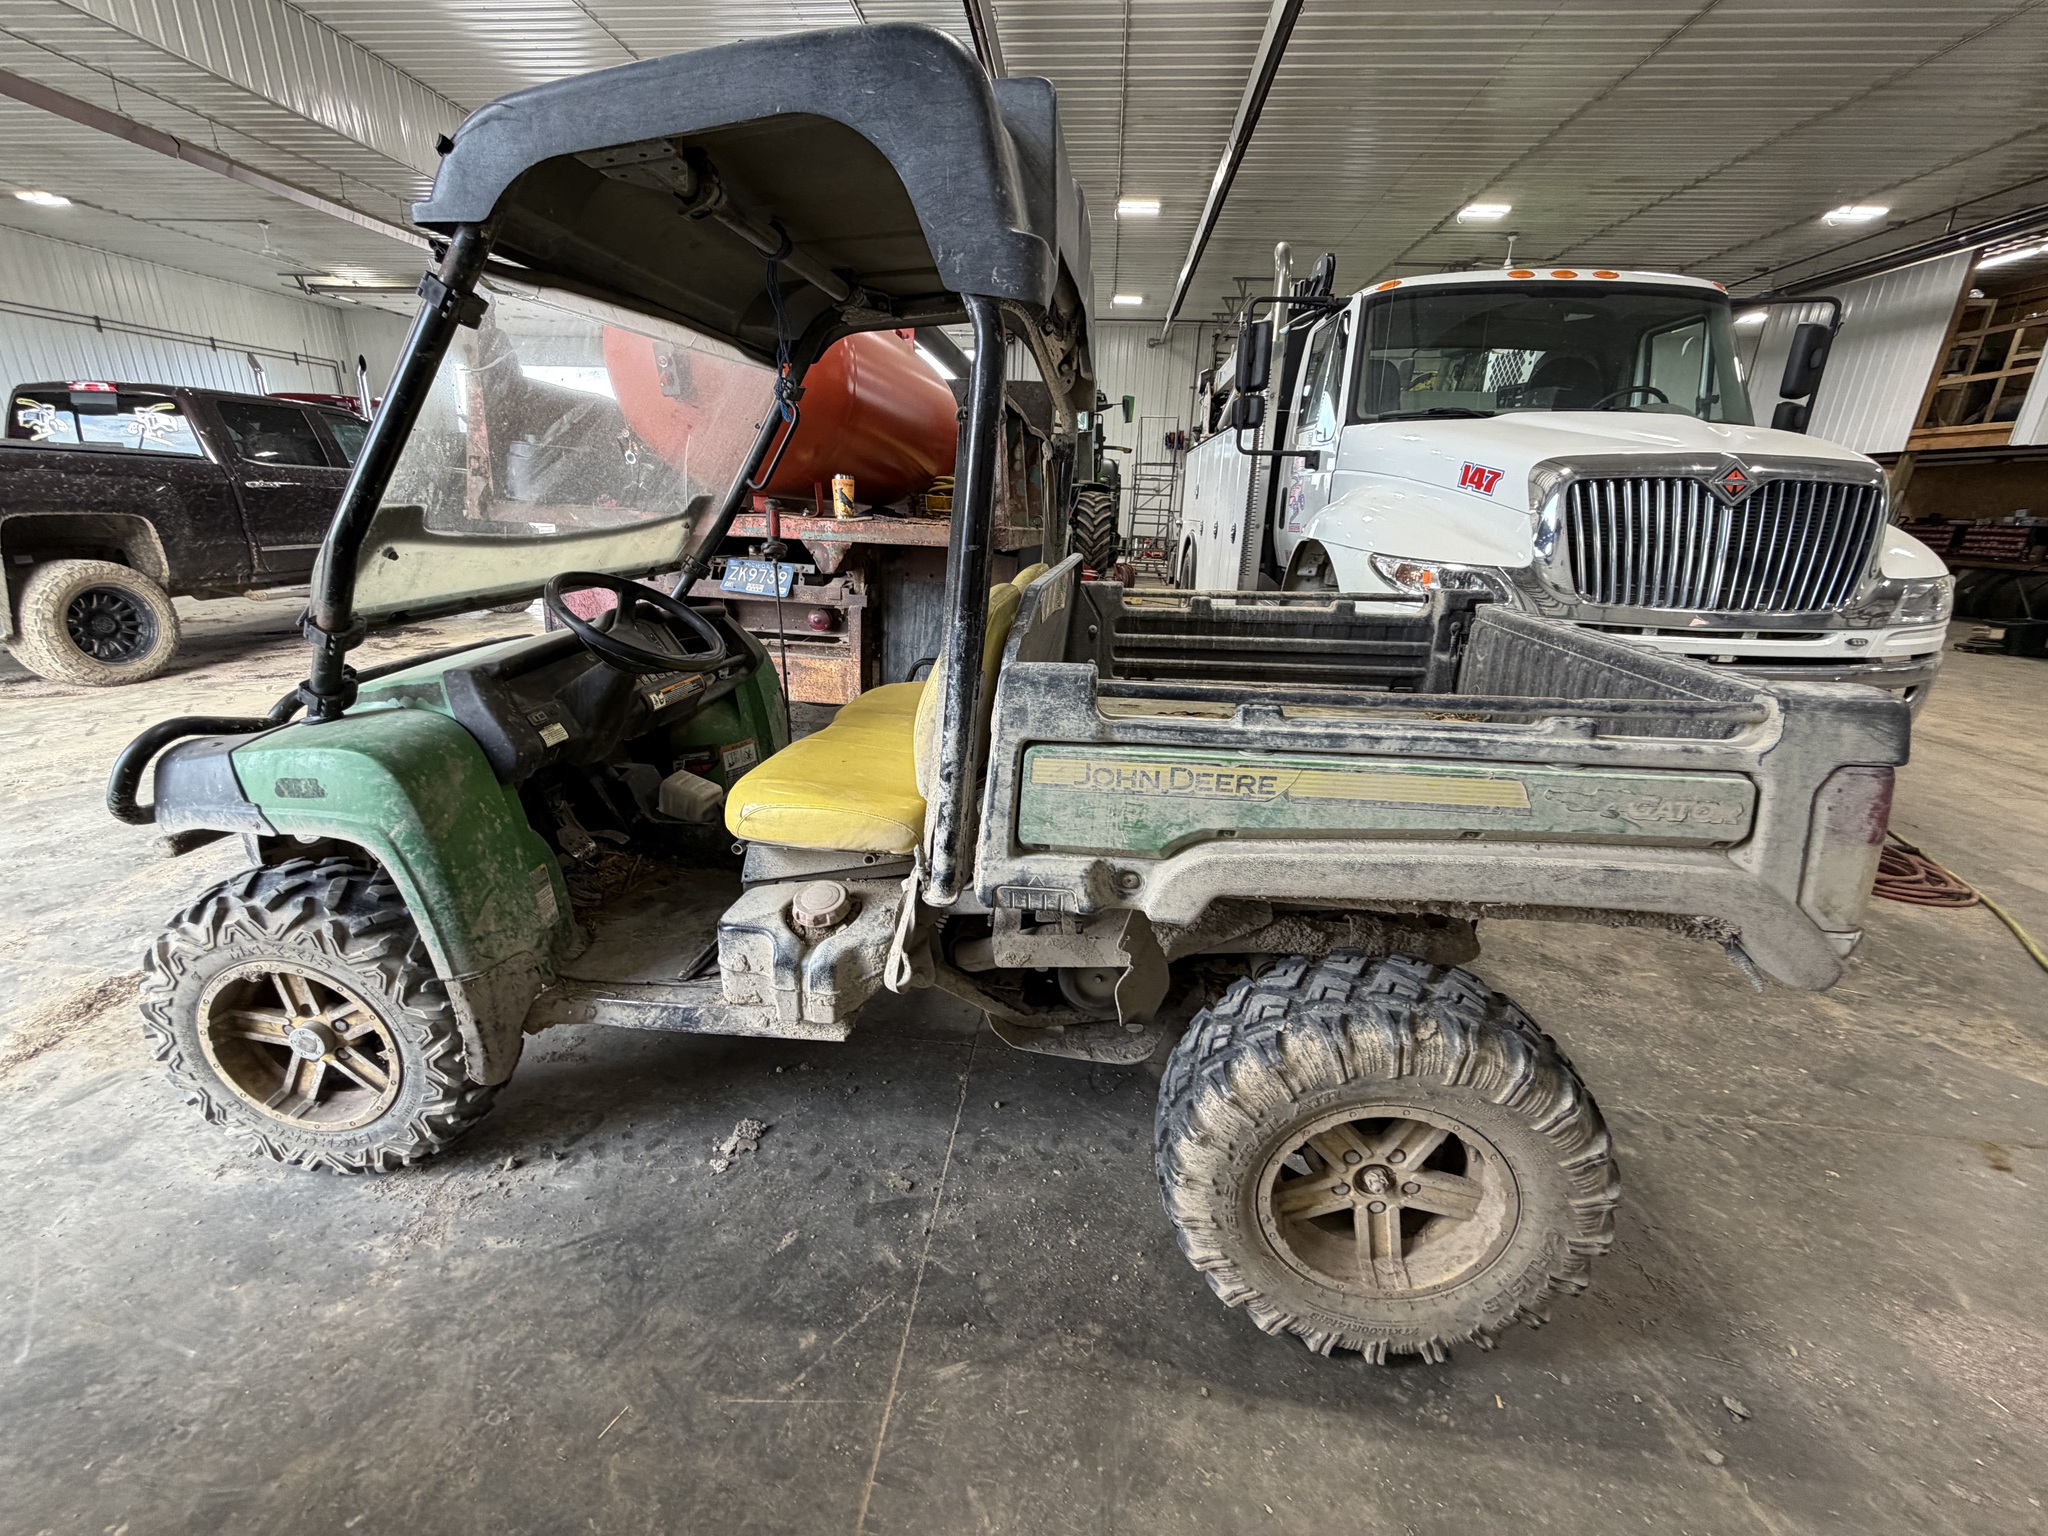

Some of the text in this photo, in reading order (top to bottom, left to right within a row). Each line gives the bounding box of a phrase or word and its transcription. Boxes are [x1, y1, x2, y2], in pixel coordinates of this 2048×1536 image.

[1458, 462, 1504, 496] 147
[728, 566, 788, 584] ZK9739
[1073, 762, 1278, 796] JOHN DEERE
[1627, 797, 1744, 826] GATOR
